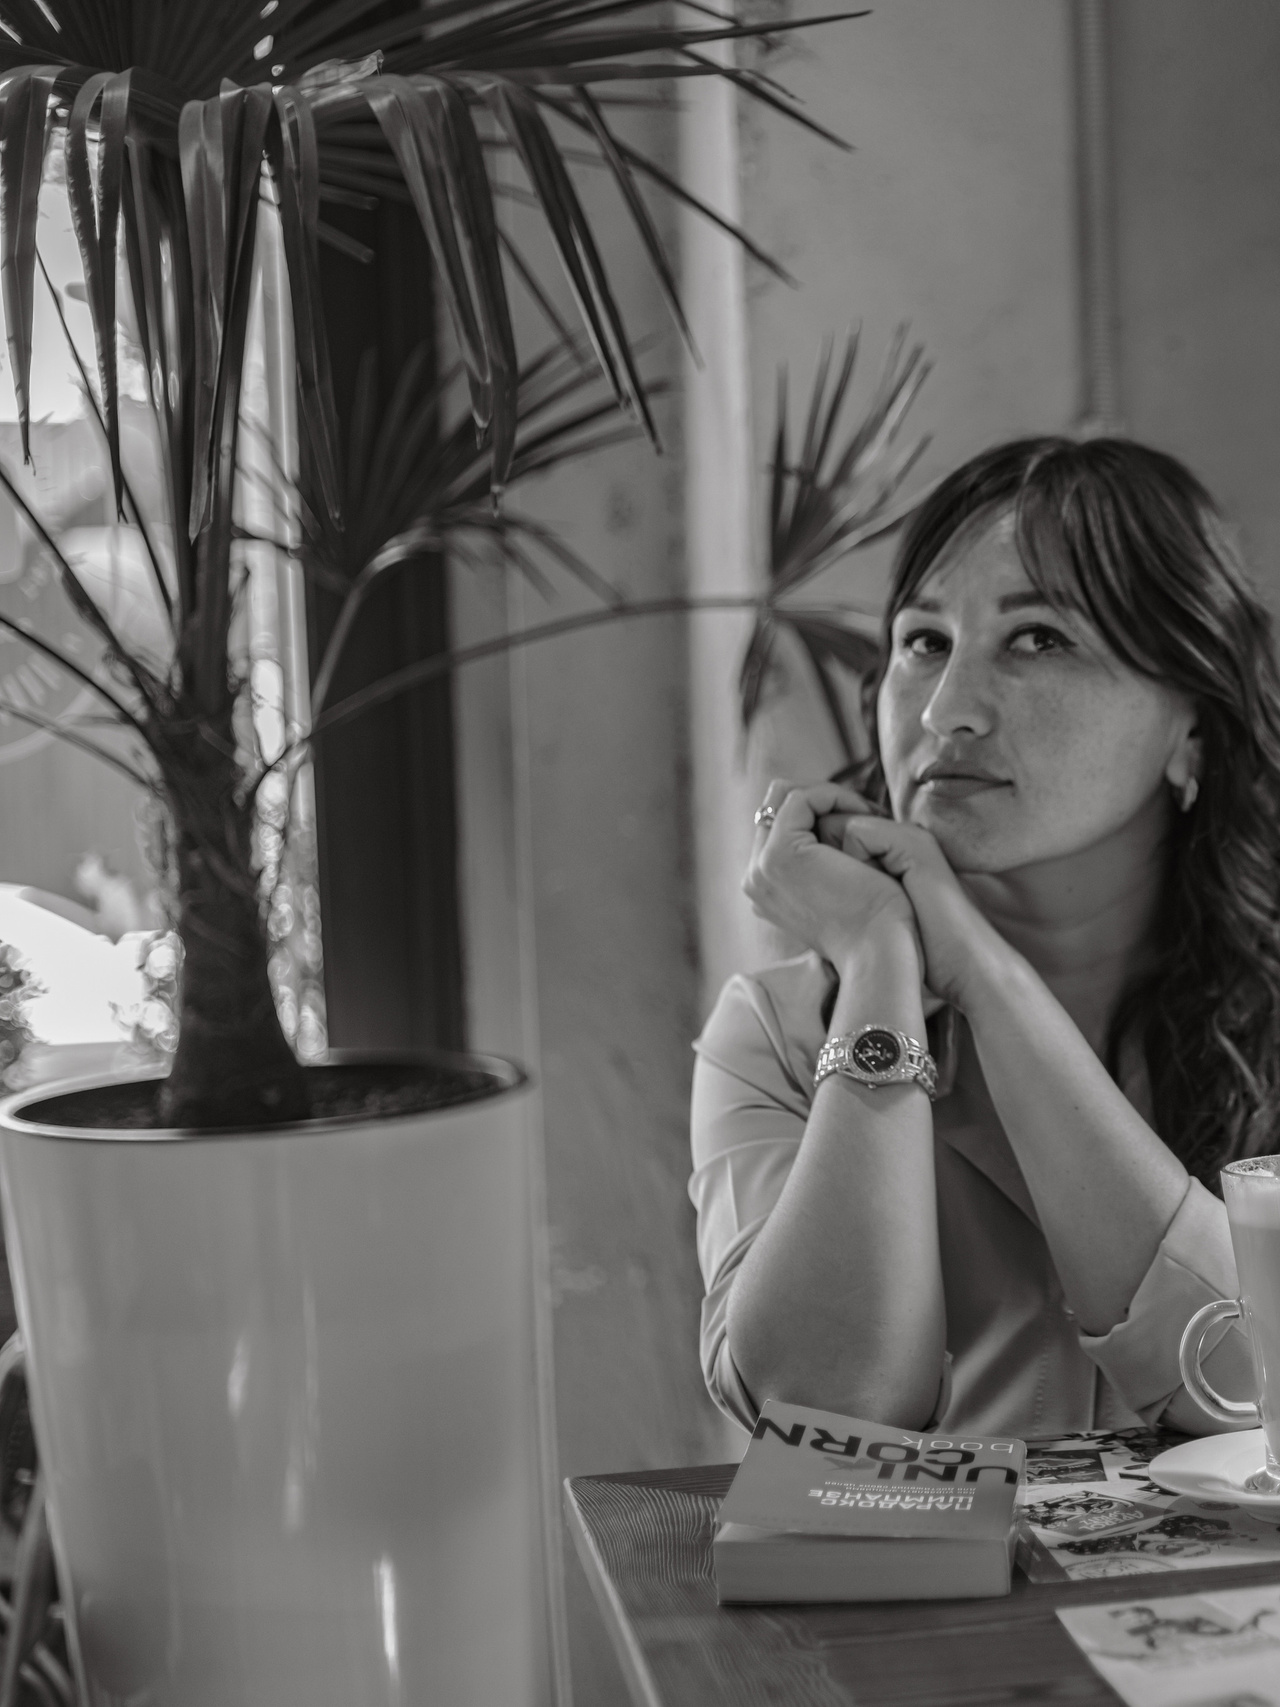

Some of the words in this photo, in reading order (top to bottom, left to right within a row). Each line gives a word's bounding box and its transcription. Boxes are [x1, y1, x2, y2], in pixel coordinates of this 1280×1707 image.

[752, 1416, 975, 1466] CORN
[901, 1436, 1014, 1455] book
[877, 1462, 1019, 1485] UNI
[807, 1489, 973, 1503] ШИМПАНЗЕ
[820, 1498, 972, 1510] ПАРАДОКС
